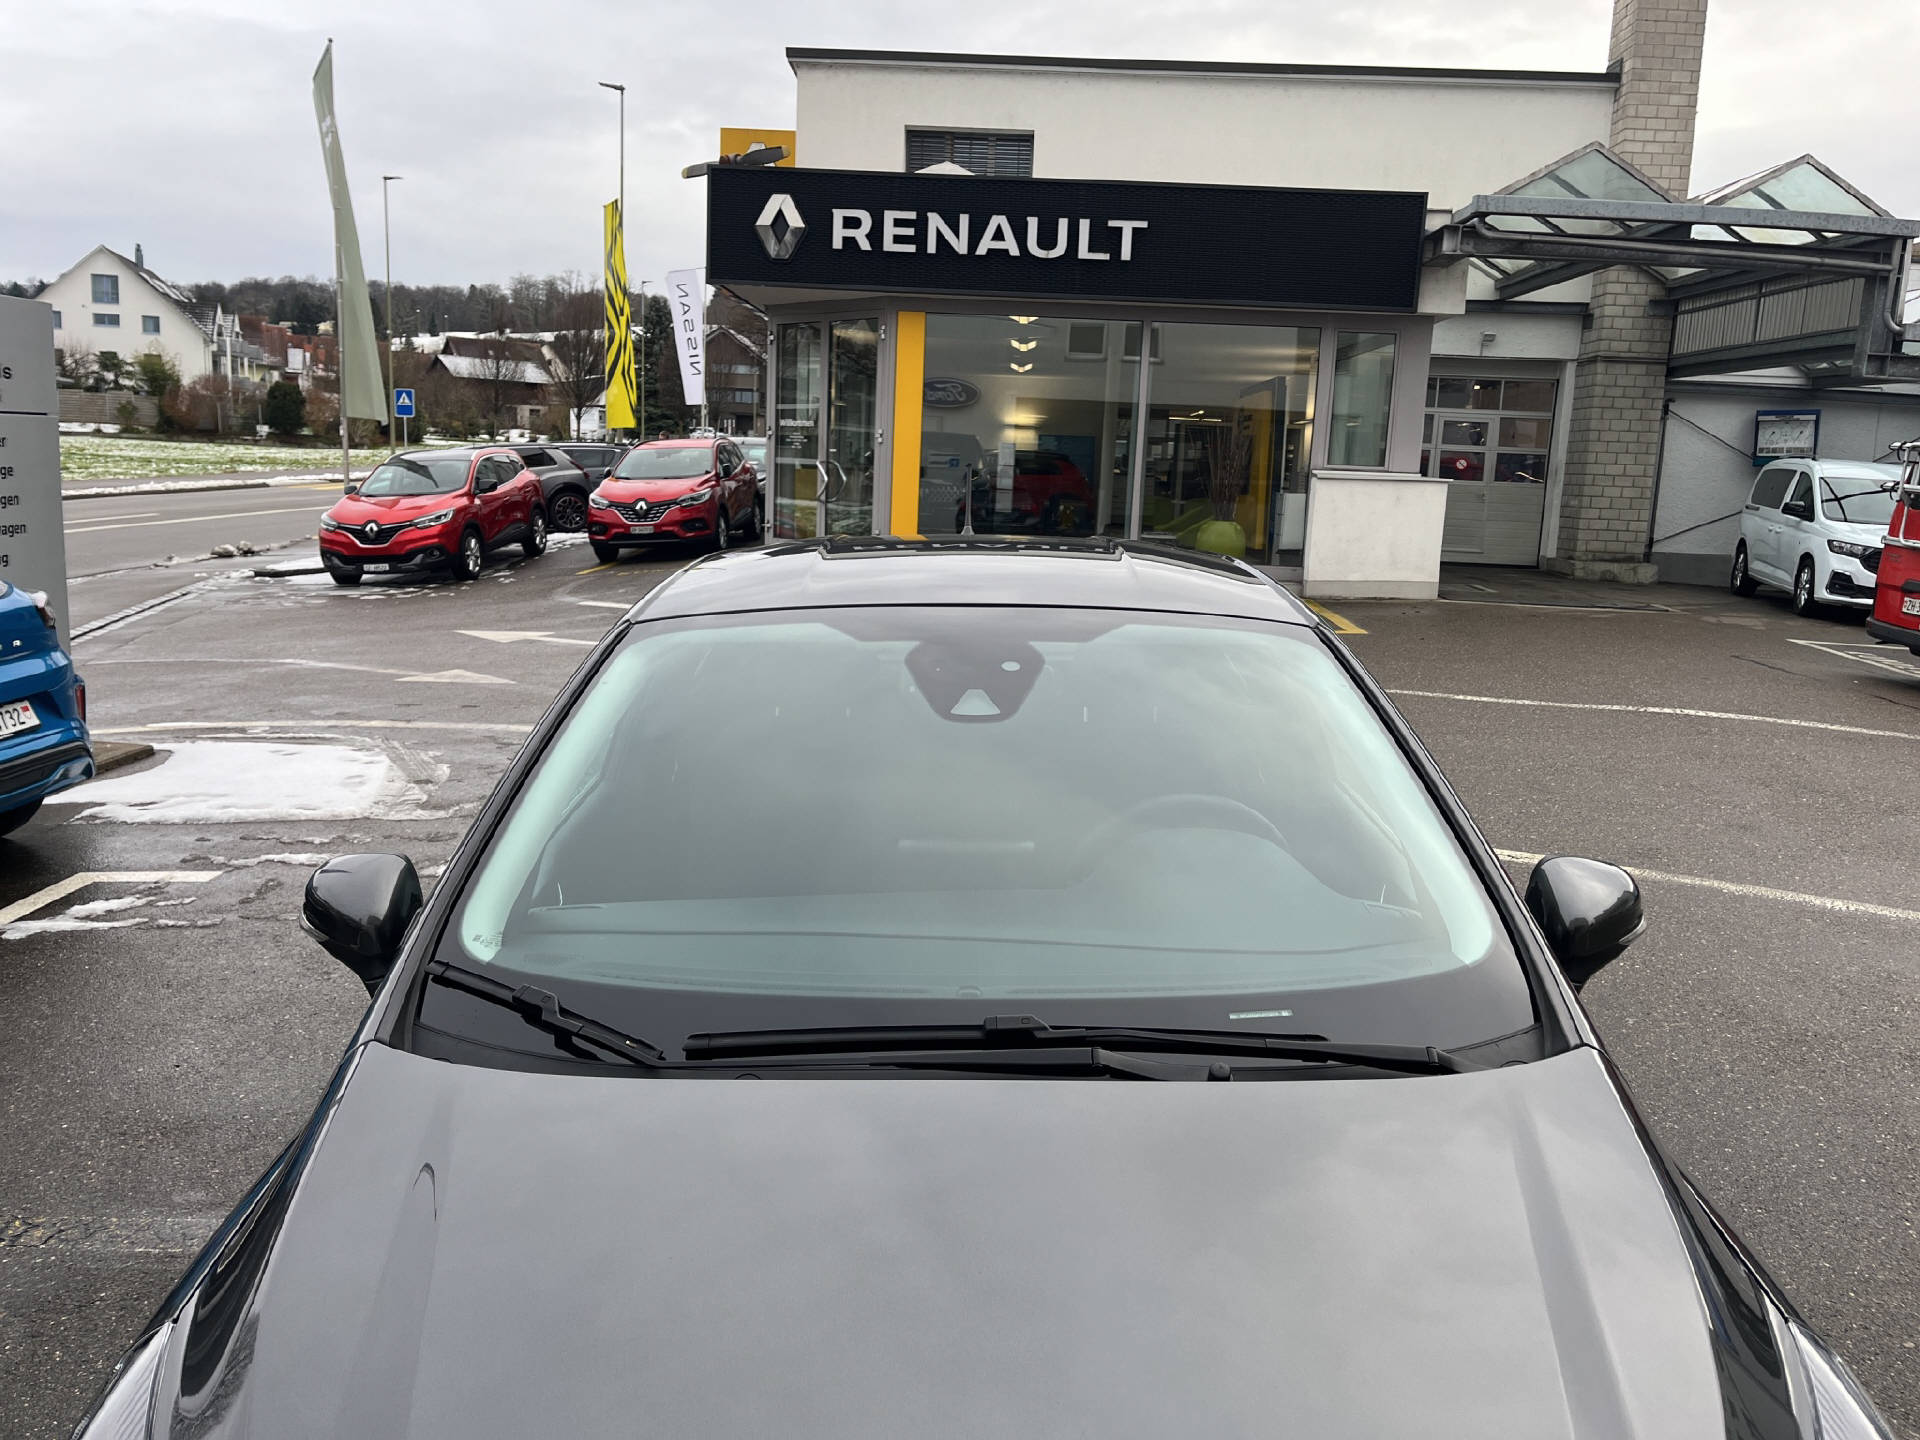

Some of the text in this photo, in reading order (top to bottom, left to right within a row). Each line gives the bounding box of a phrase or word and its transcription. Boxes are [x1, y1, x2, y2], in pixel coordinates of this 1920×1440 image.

[832, 208, 1149, 261] RENAULT
[0, 366, 12, 380] s
[0, 496, 19, 509] gen
[0, 524, 26, 538] agen
[0, 554, 9, 568] g
[0, 708, 26, 730] 732
